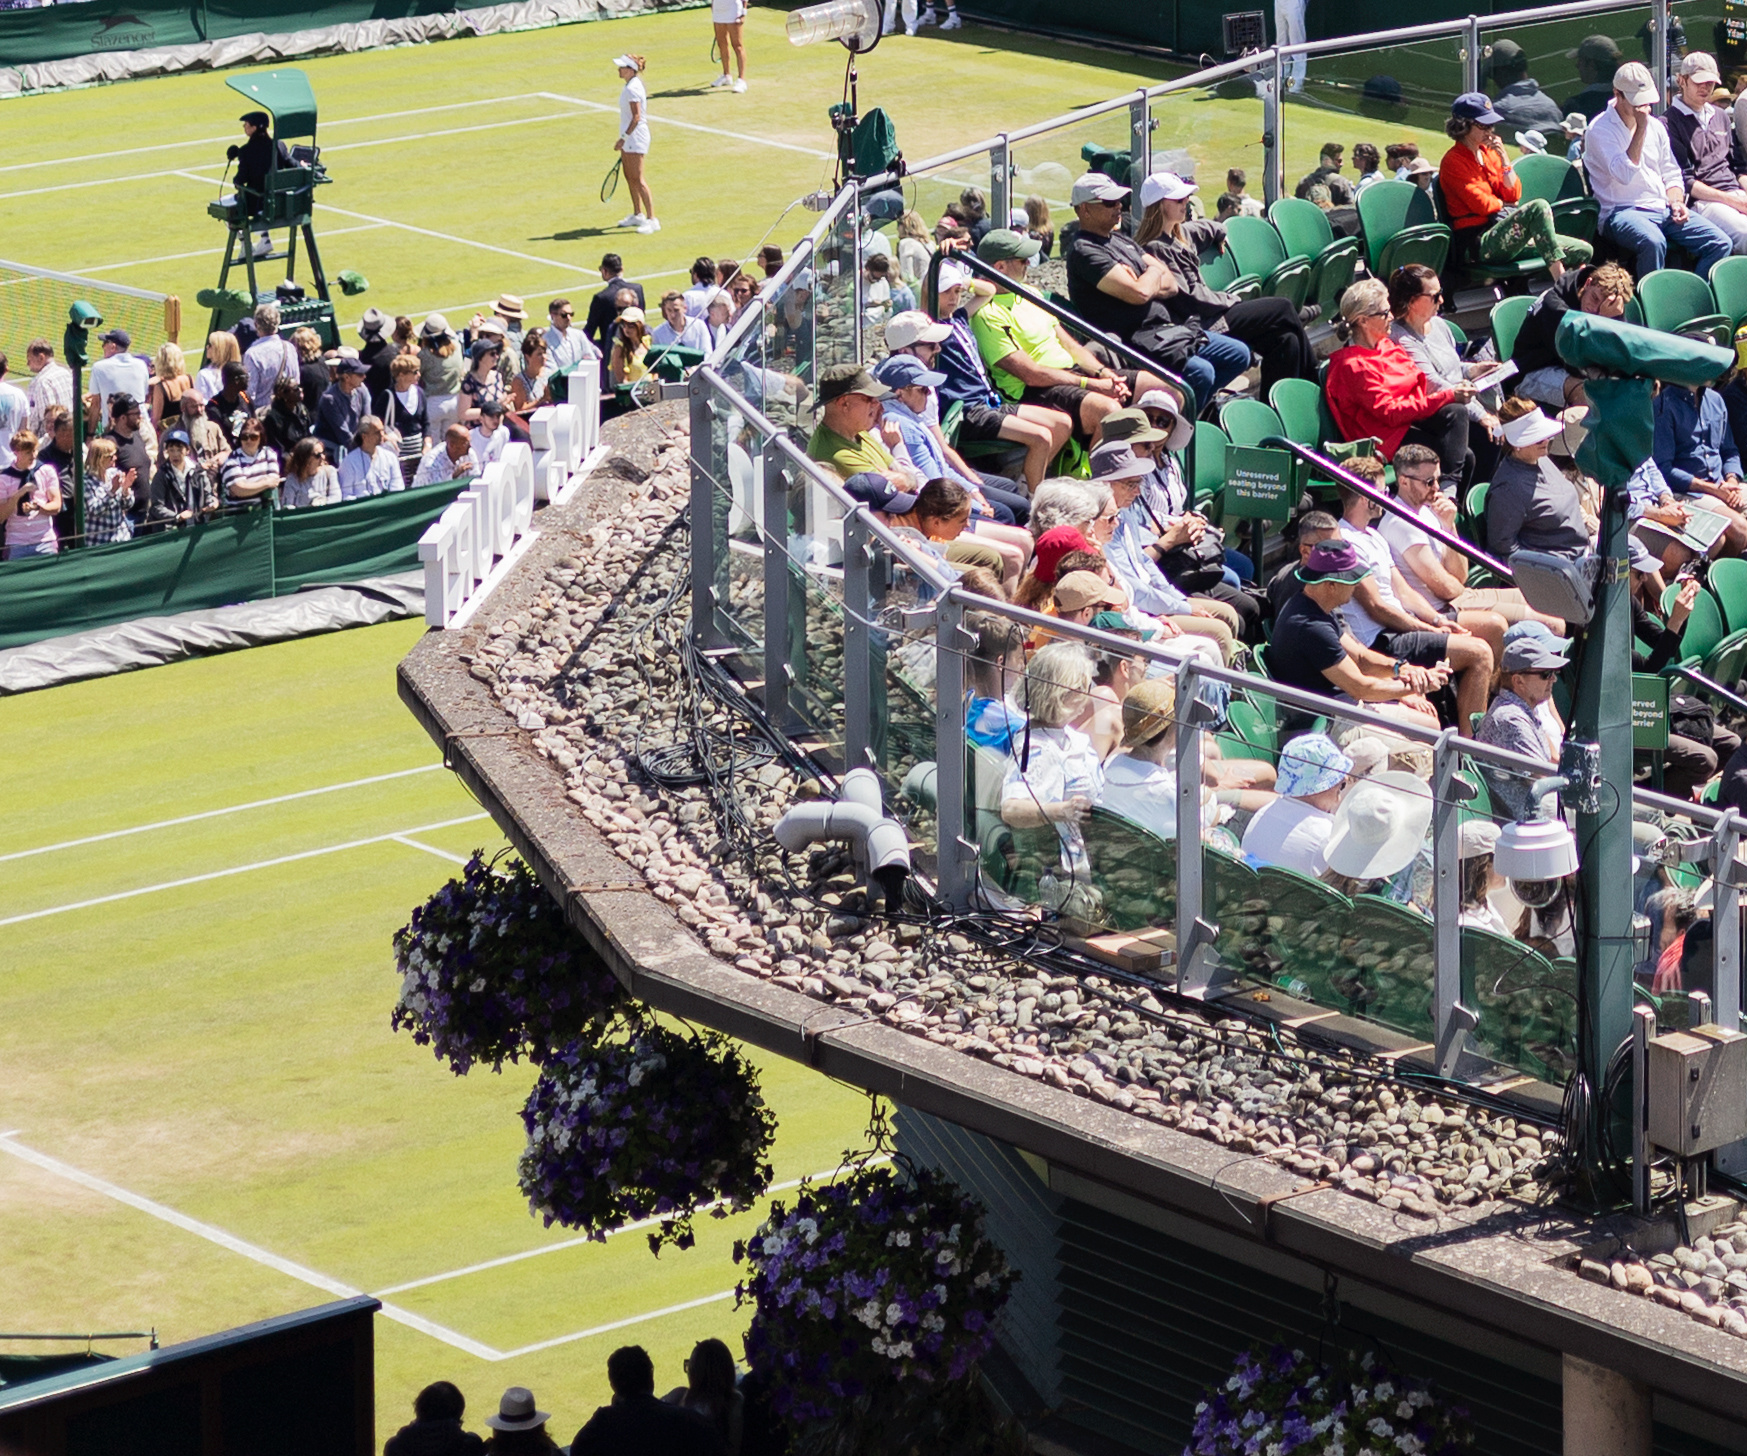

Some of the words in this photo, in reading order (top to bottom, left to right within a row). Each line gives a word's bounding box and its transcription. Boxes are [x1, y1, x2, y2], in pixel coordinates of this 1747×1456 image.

[1235, 469, 1280, 481] Unreserved
[1228, 479, 1256, 489] seating
[1258, 481, 1287, 491] beyond
[1236, 489, 1251, 497] this
[1252, 490, 1278, 500] barrier
[1633, 709, 1664, 718] beyond
[1632, 719, 1655, 727] arrier
